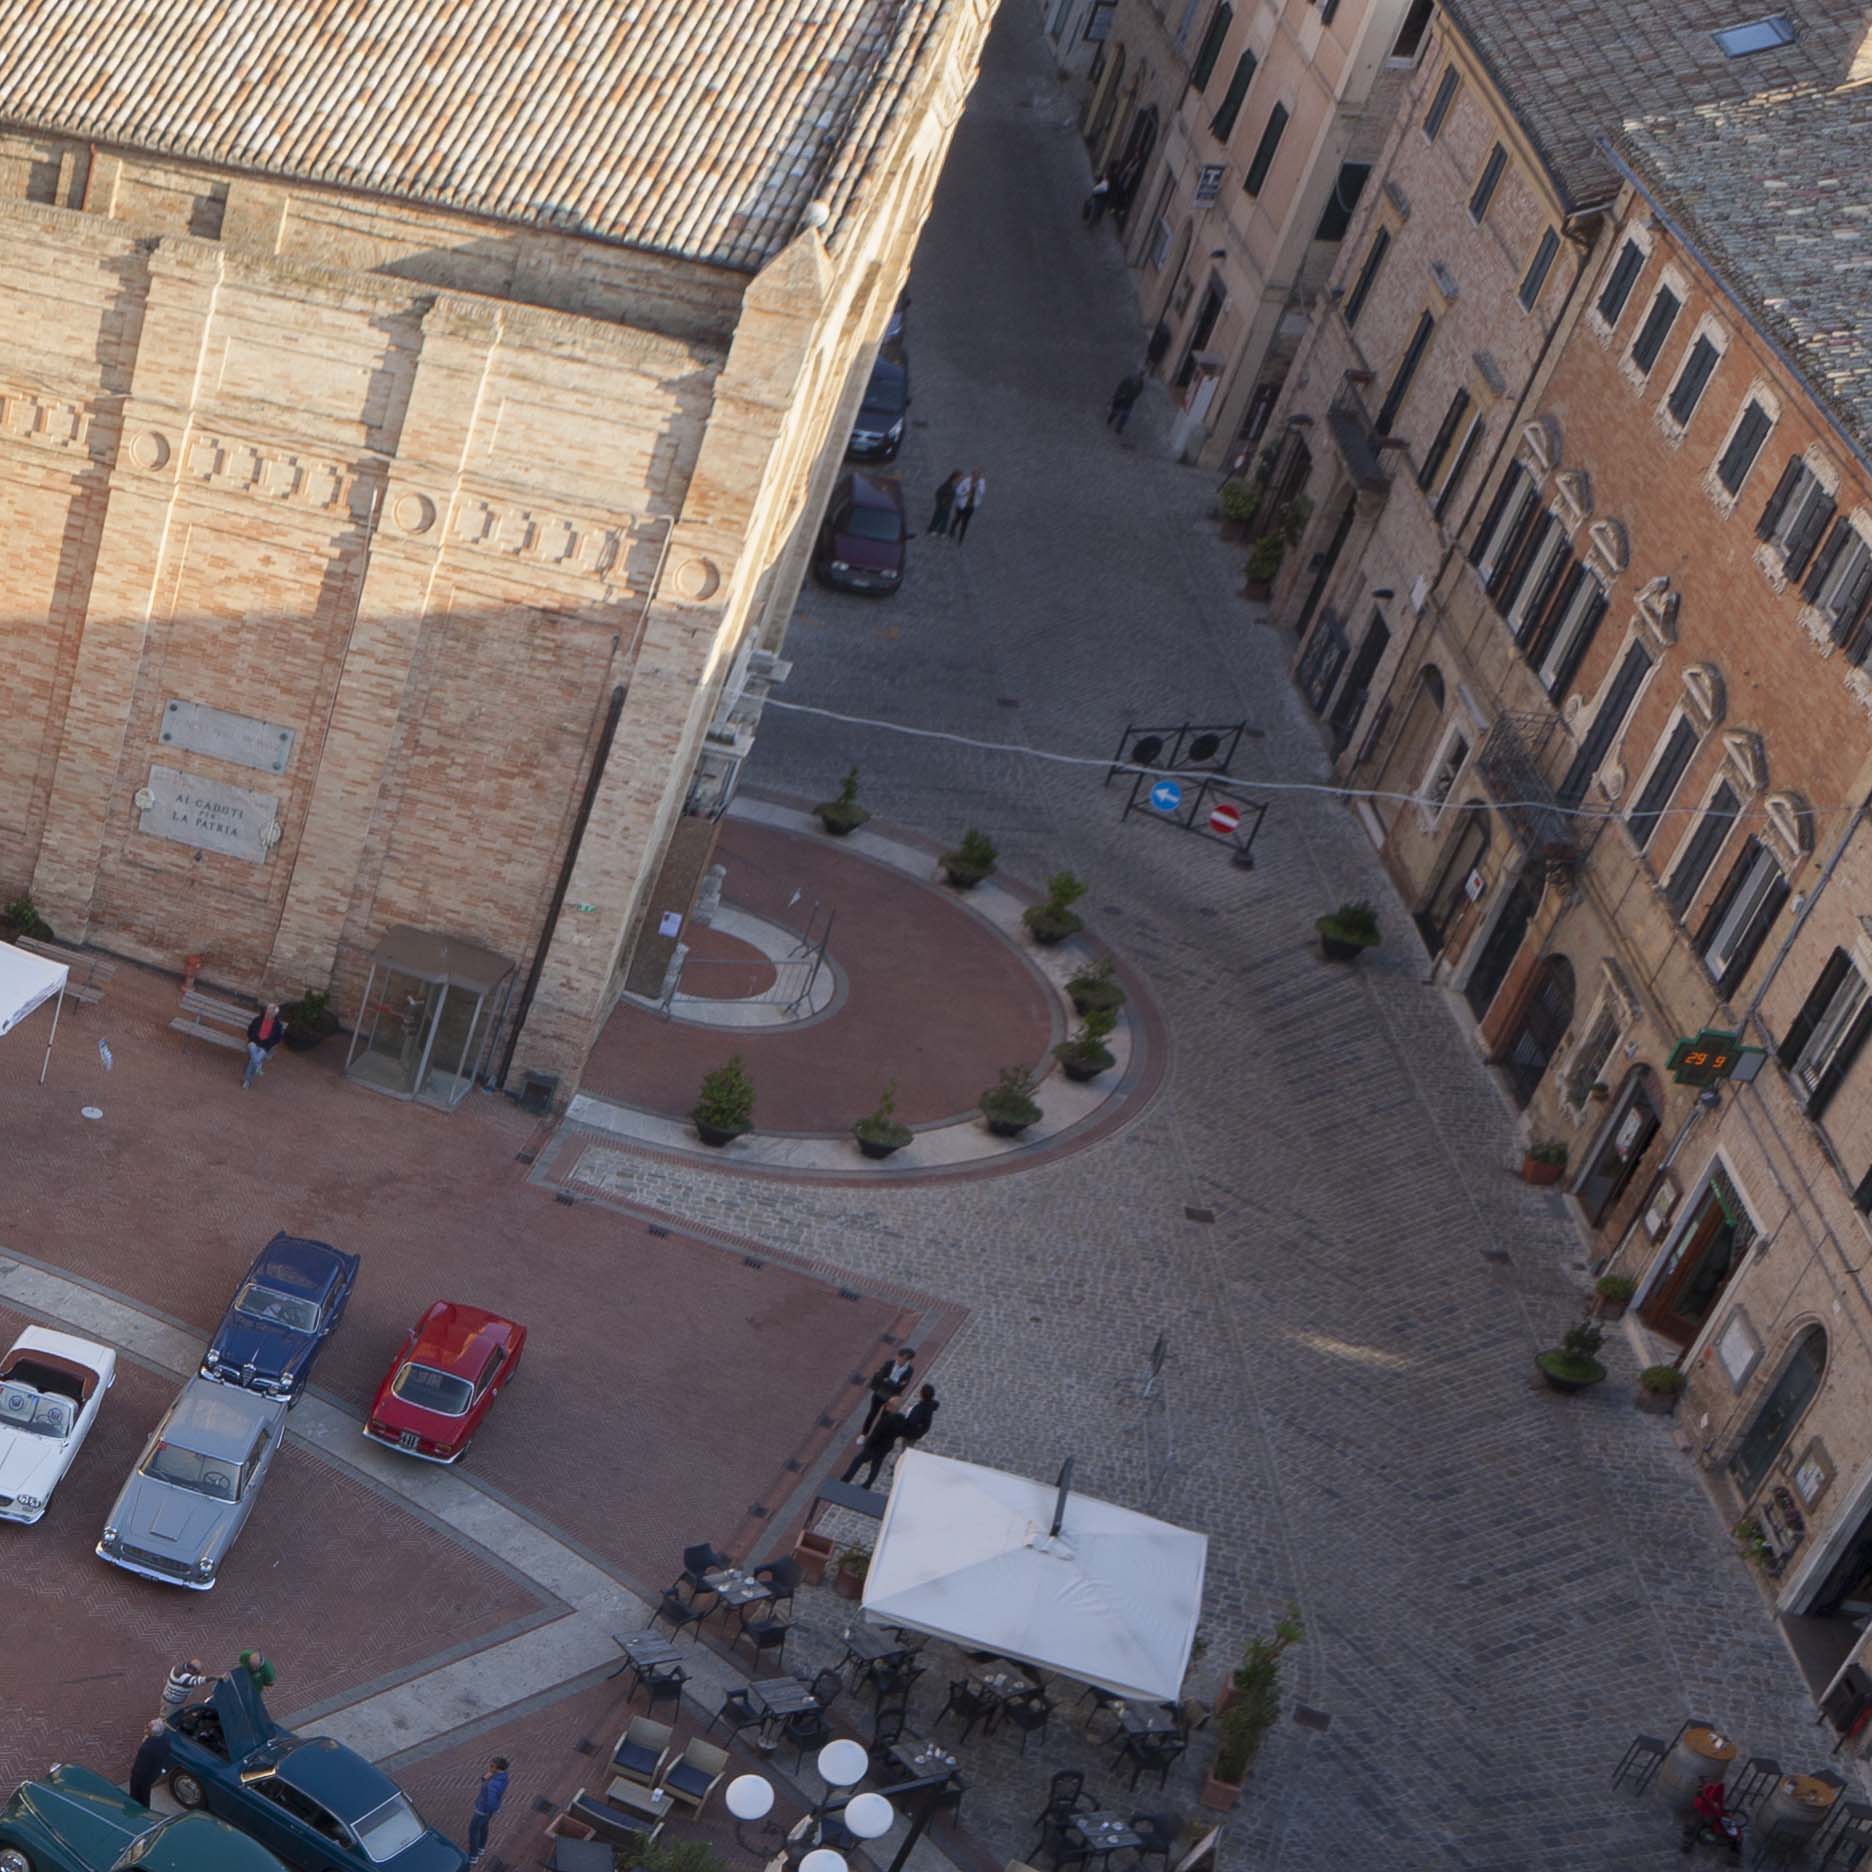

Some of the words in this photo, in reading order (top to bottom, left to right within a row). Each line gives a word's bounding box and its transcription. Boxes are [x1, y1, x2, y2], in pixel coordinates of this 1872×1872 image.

[194, 799, 244, 820] CADUTI
[171, 811, 189, 824] LA
[195, 818, 239, 836] PATRIA
